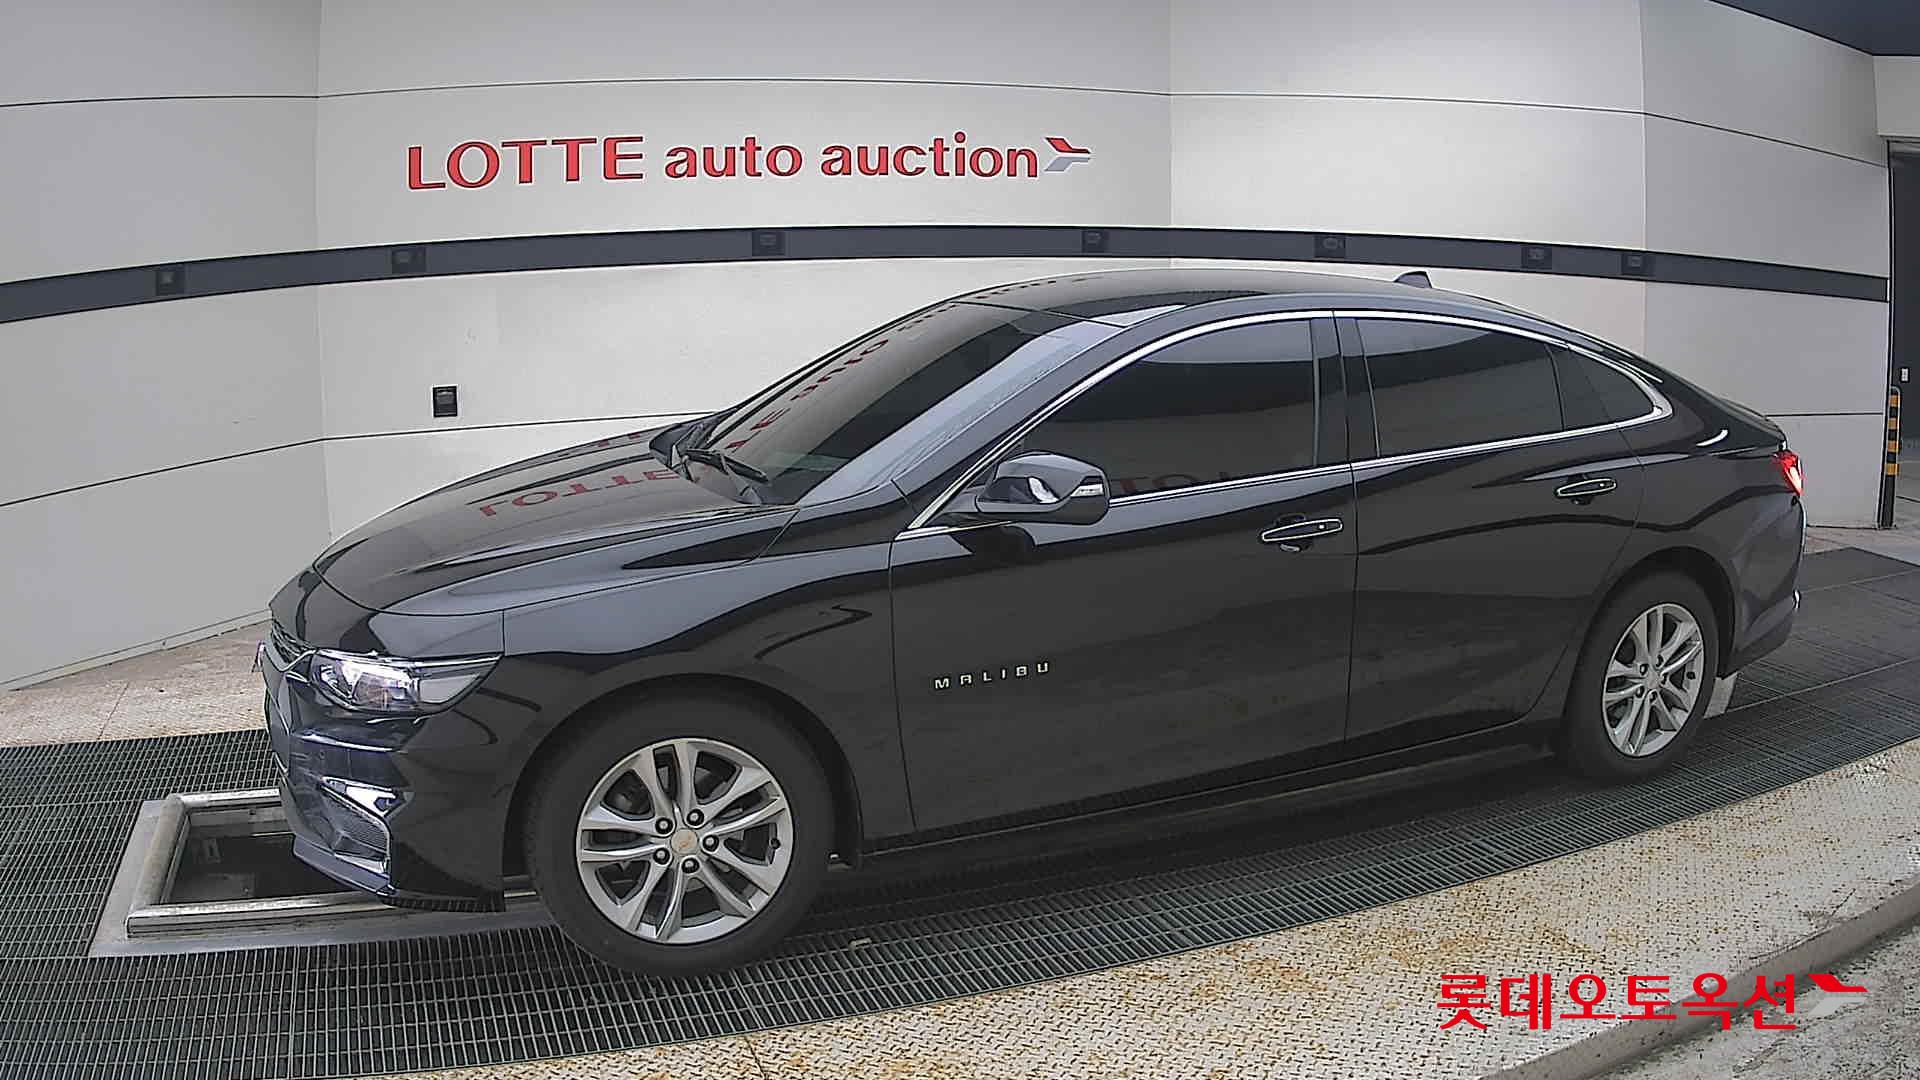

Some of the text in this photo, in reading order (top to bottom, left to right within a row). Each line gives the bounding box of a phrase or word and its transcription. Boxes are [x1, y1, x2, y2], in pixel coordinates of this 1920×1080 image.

[408, 131, 1039, 190] LOTTE auto auction
[934, 662, 1050, 690] MALIBU
